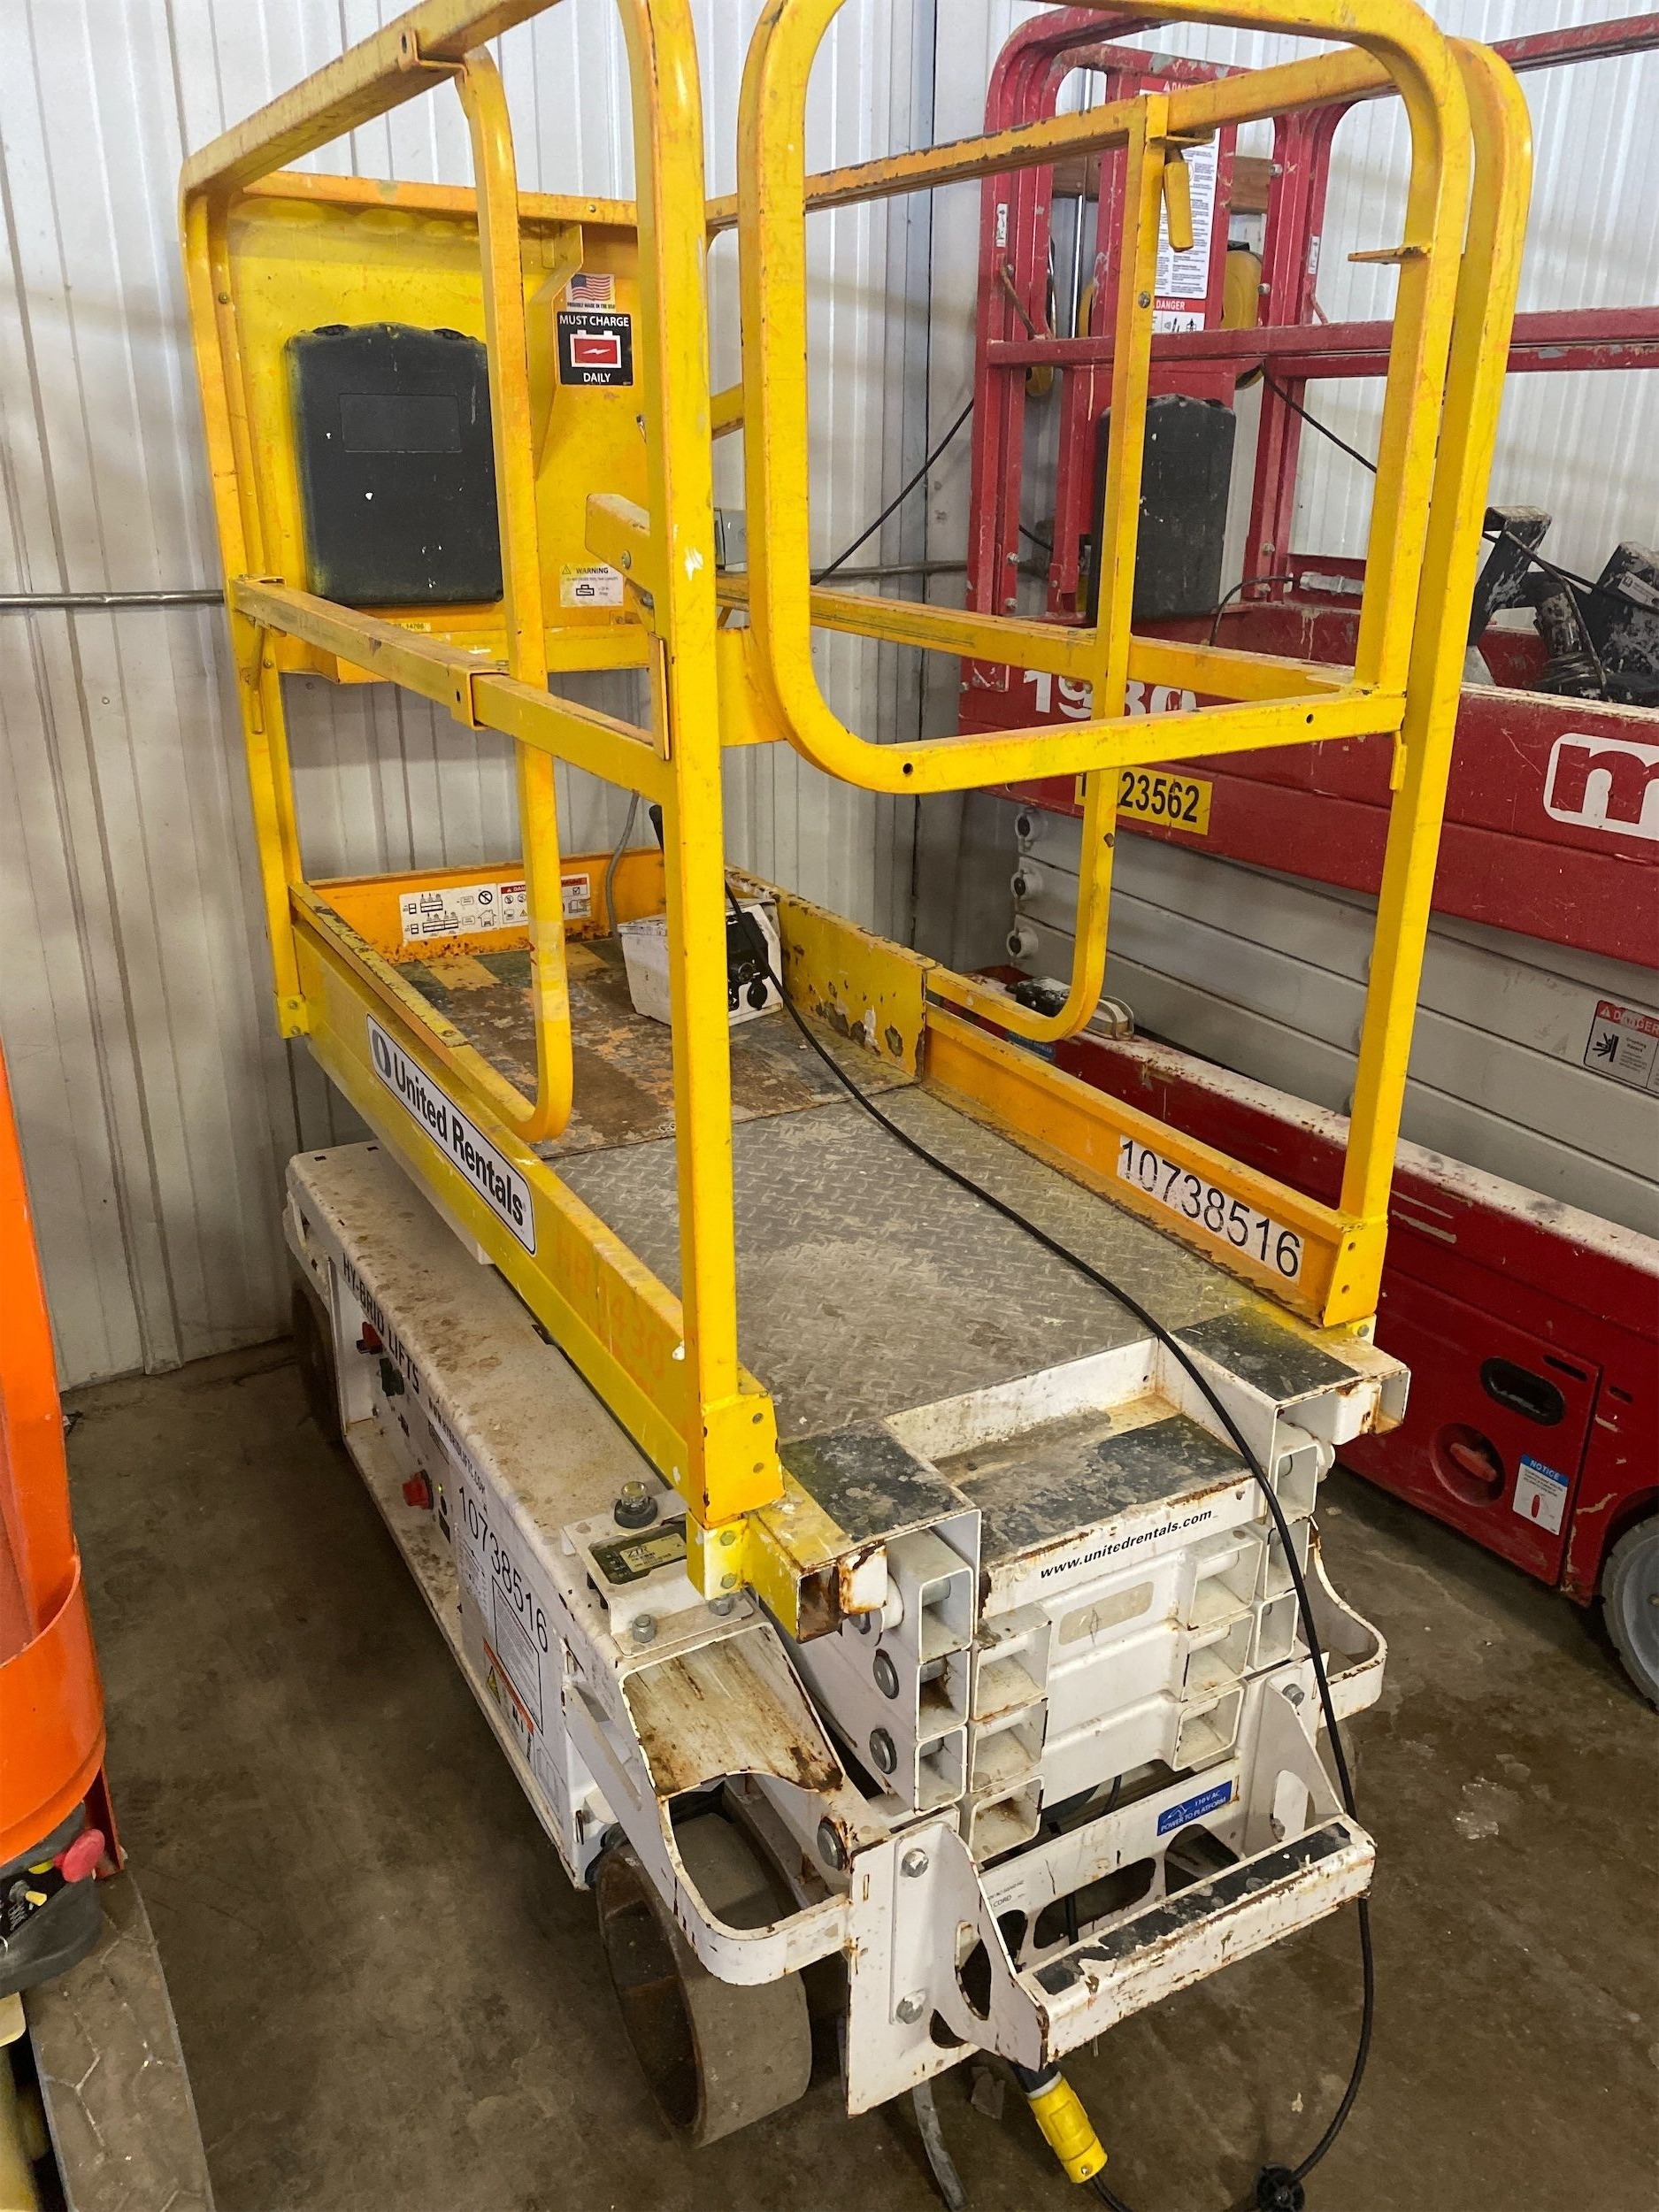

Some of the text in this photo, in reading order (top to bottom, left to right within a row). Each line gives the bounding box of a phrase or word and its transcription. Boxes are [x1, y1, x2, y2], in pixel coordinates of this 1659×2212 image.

[559, 314, 629, 327] MUST CHARGE
[1156, 300, 1185, 310] DANGER
[583, 373, 611, 383] DAILY
[394, 1052, 524, 1226] United Rentals
[1122, 1140, 1301, 1278] 10738516
[388, 1323, 419, 1395] LIFTS
[1530, 1459, 1561, 1481] NOTICE
[459, 1486, 548, 1653] 10738516
[1040, 1509, 1212, 1579] www.unitedrentals.com
[1160, 1796, 1226, 1832] POWER TO PLATFORM
